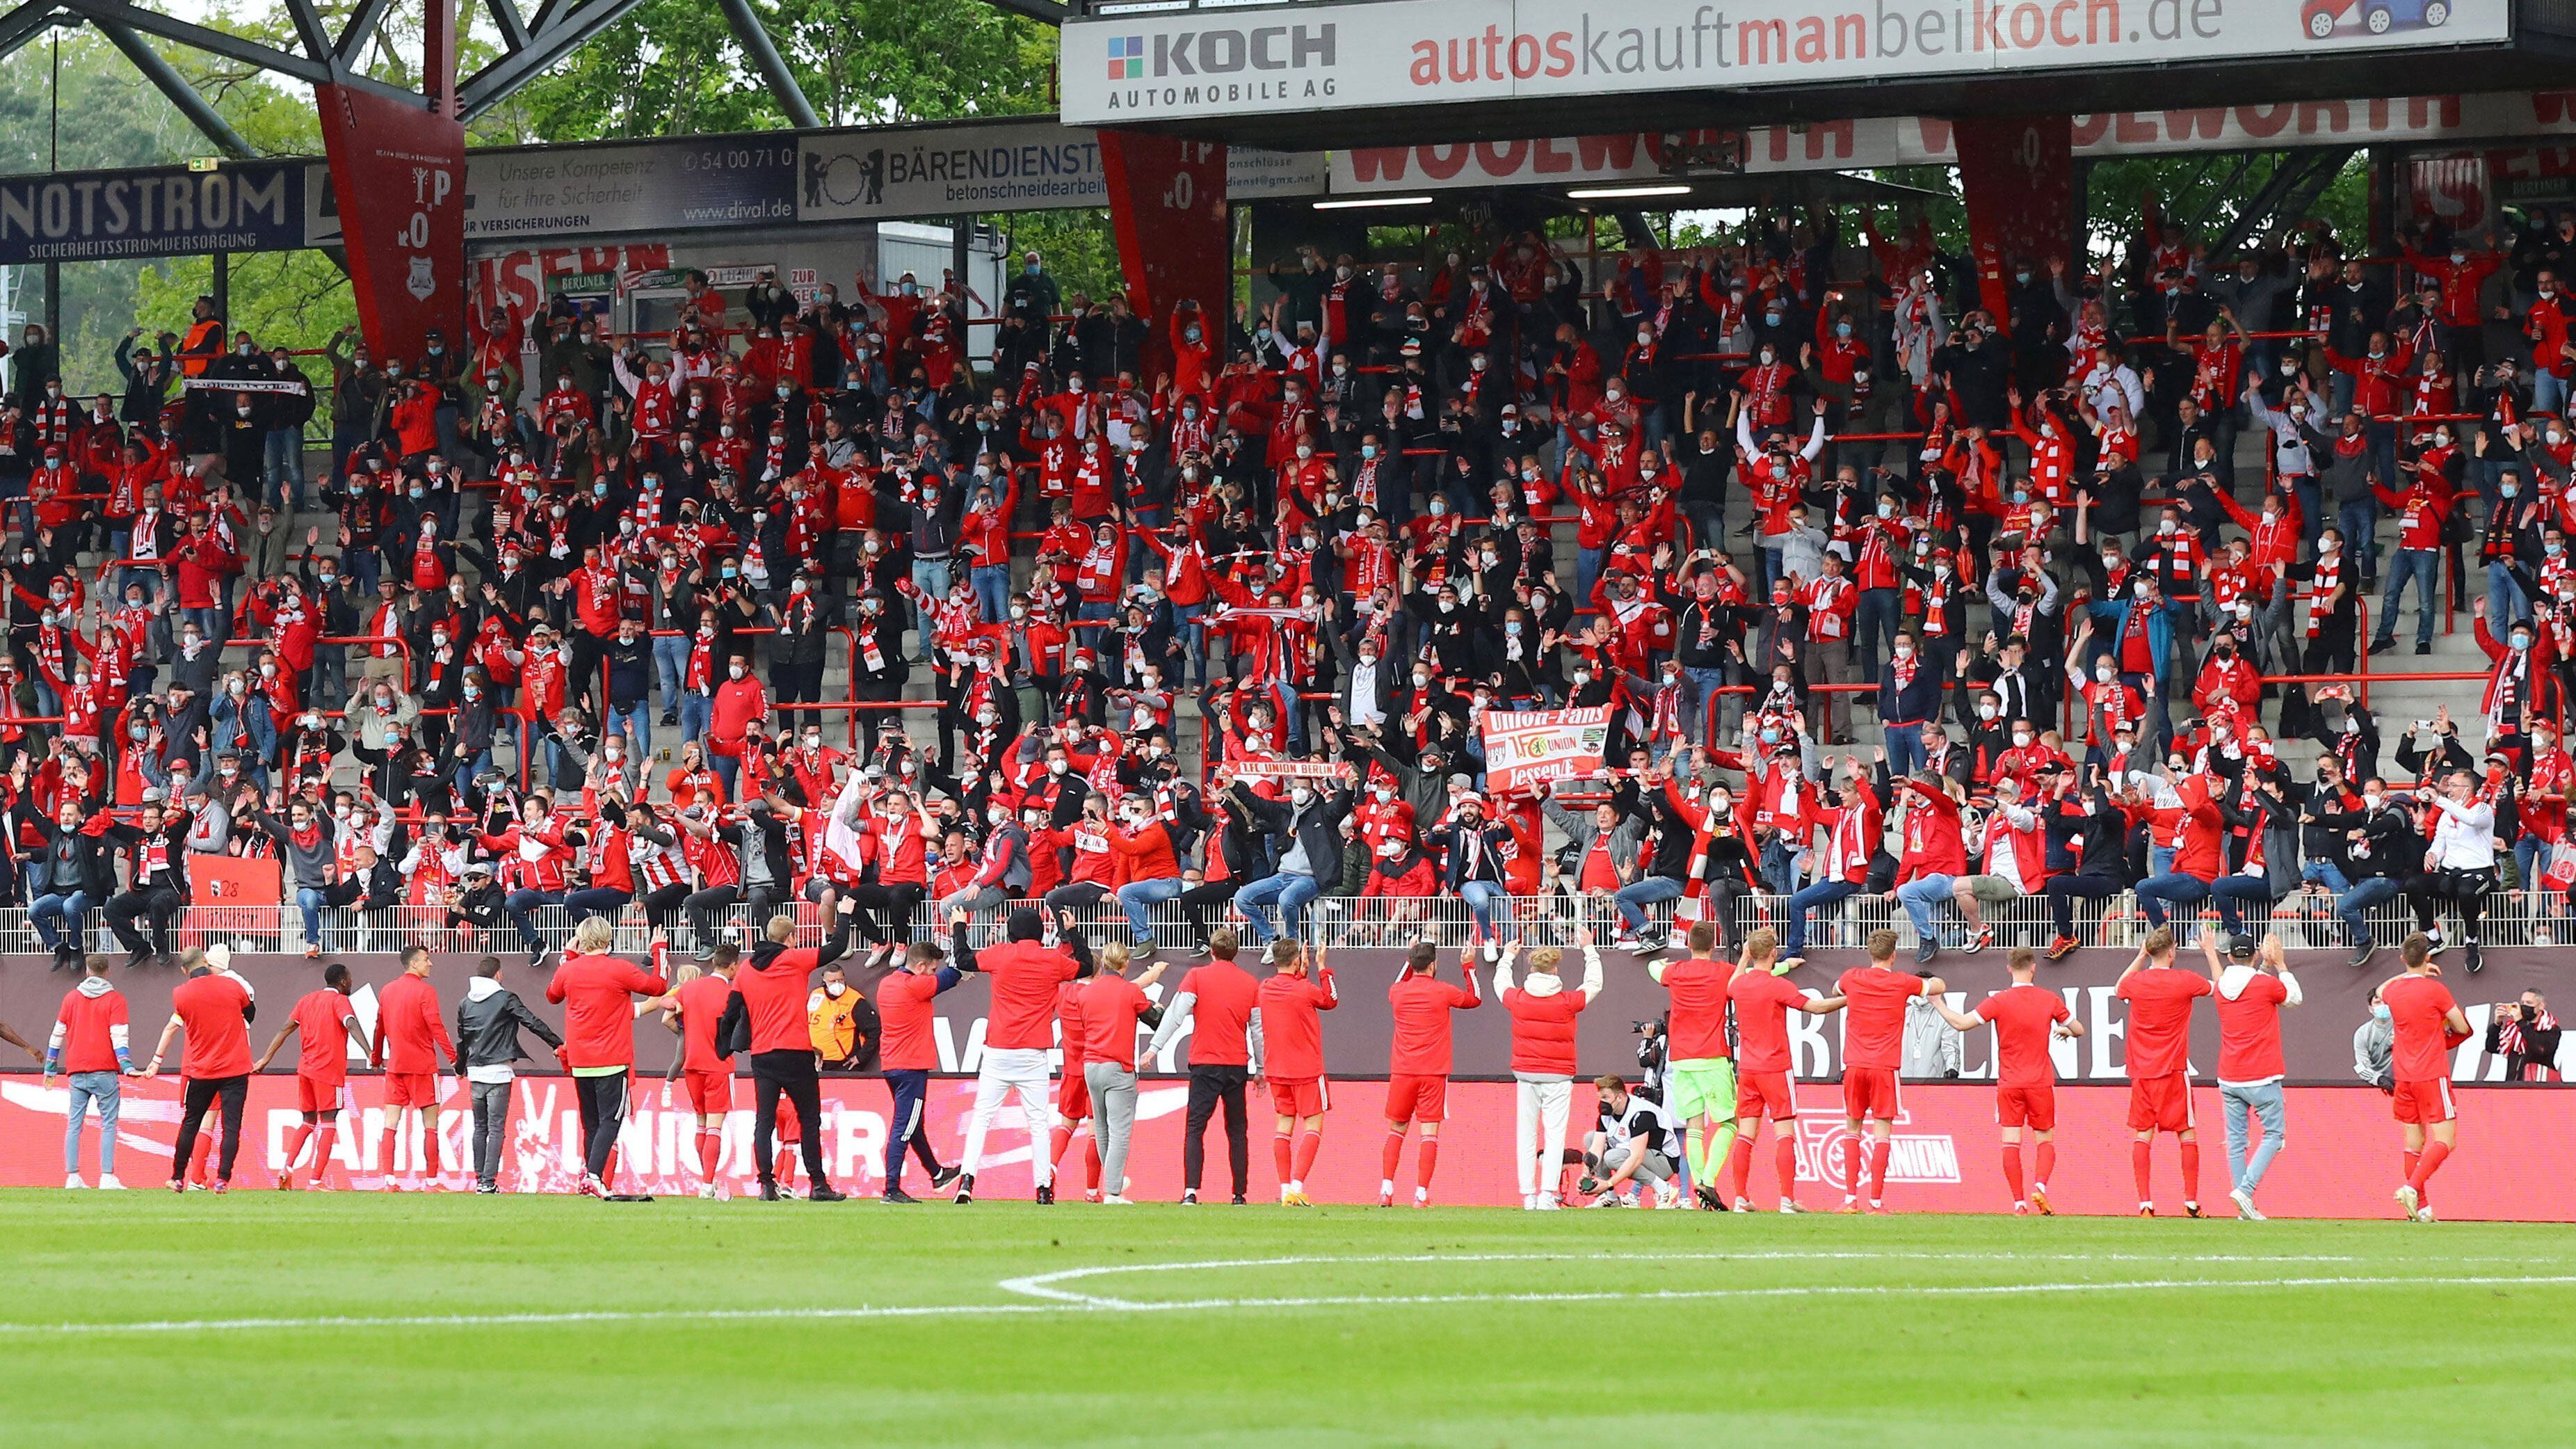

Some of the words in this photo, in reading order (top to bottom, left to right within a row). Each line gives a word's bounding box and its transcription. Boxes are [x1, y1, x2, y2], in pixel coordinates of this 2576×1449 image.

[1153, 23, 1336, 77] KOCH
[1109, 81, 1288, 109] AUTOMOBILE
[1303, 78, 1336, 104] AG
[499, 161, 555, 182] Unsere
[562, 158, 655, 179] Kompetenz
[702, 152, 722, 170] 54
[727, 150, 750, 168] 00
[756, 149, 774, 167] 71
[781, 148, 793, 166] 0
[889, 143, 1098, 184] BÄRENDIENST
[0, 170, 285, 240] NOTSTROM
[497, 188, 520, 209] für
[524, 186, 555, 207] Ihre
[561, 183, 643, 205] Sicherheit
[683, 198, 792, 222] www.dival.de
[482, 214, 590, 231] VERSICHERUNGEN
[29, 232, 257, 259] SICHERHEITSSTROMVERSORGUNG
[562, 274, 606, 290] BERLINER
[791, 269, 816, 284] ZUR
[1489, 705, 1604, 732] Union-Fans
[1547, 736, 1578, 752] UNION
[1265, 763, 1297, 774] UNION
[1301, 764, 1333, 774] BERLIN
[222, 880, 239, 897] 28
[267, 1108, 504, 1171] DANK
